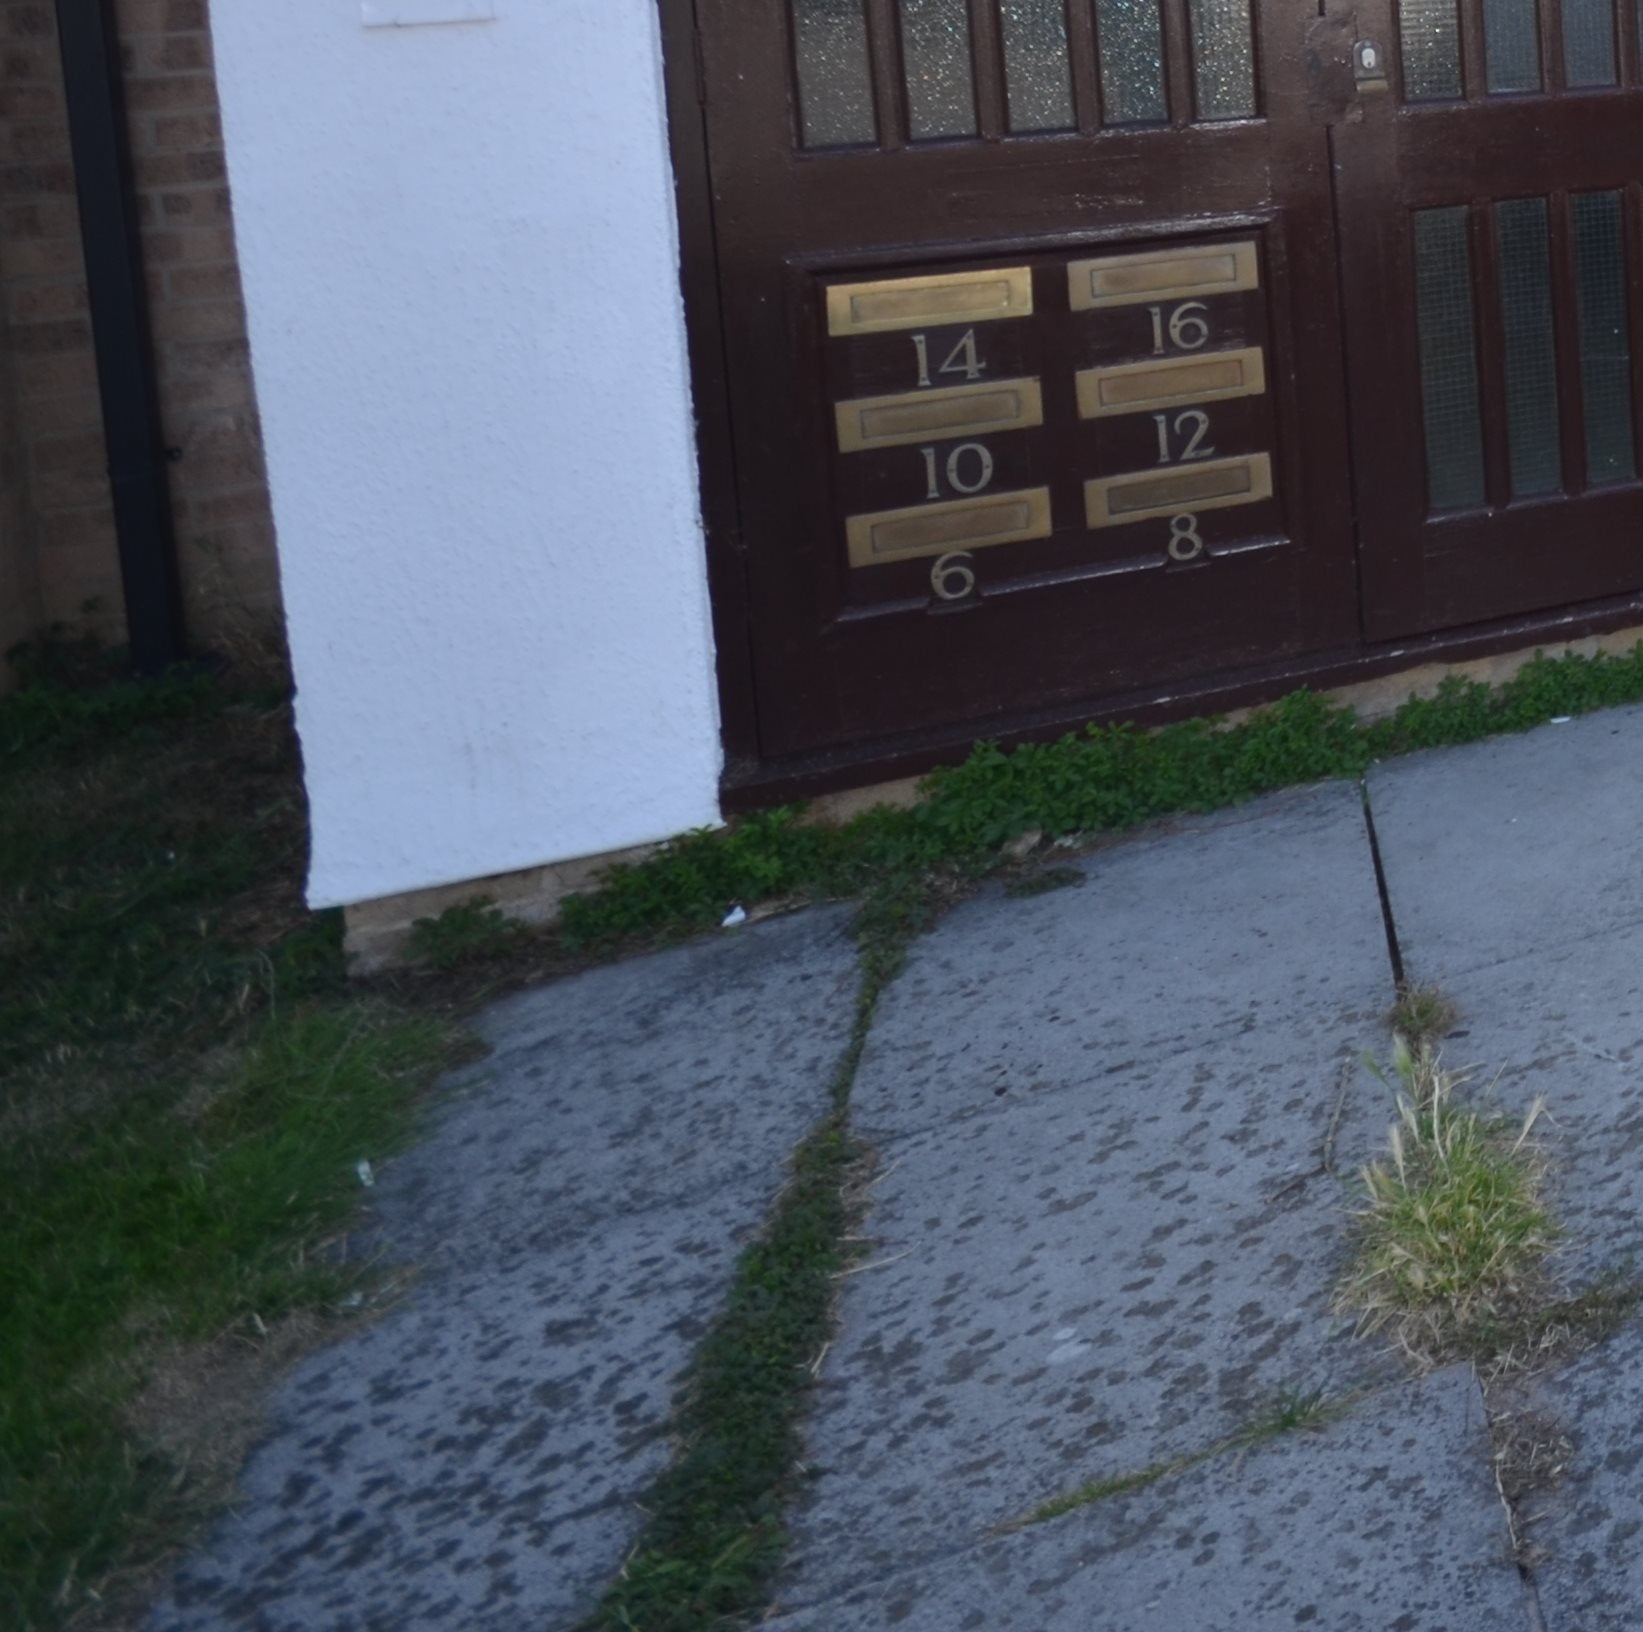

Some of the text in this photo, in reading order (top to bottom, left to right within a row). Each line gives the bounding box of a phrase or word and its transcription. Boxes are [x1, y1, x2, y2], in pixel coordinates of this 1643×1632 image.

[1149, 301, 1209, 356] 16
[911, 328, 987, 387] 14
[1152, 410, 1215, 463] 12
[920, 442, 994, 500] 10
[1167, 512, 1203, 562] 8
[930, 550, 976, 601] 6
